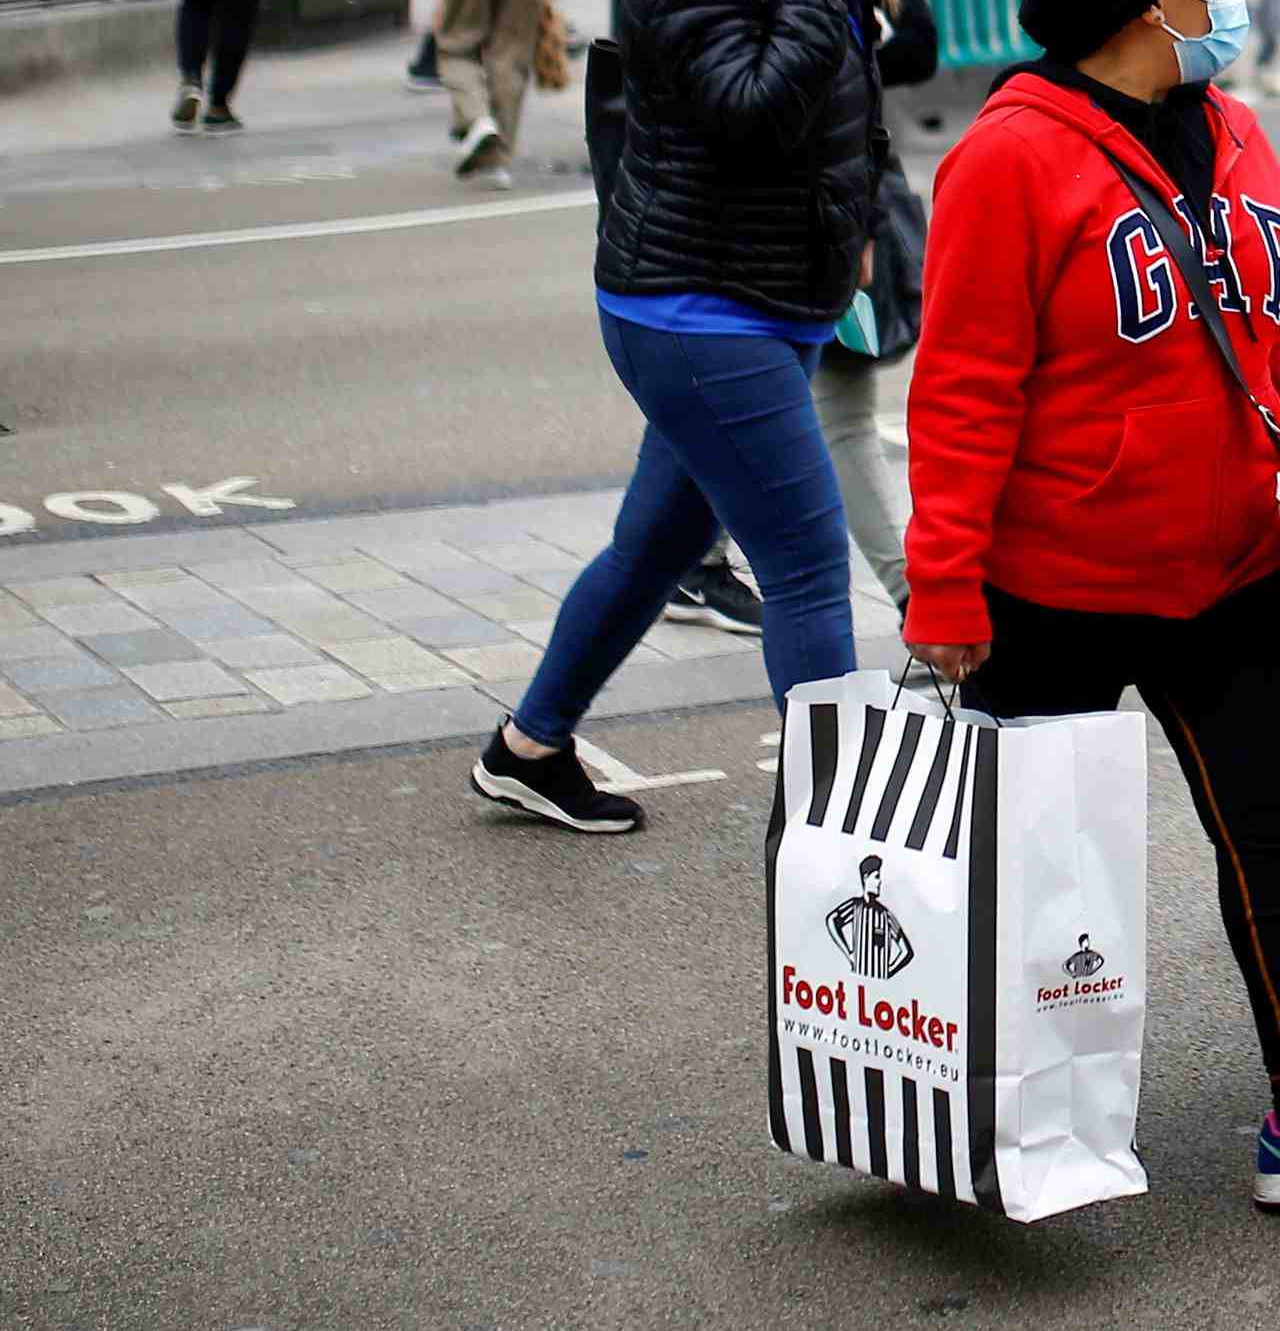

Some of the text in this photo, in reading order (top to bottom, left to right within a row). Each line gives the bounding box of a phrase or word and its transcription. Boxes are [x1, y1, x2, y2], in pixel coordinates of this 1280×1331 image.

[783, 964, 959, 1053] Foot Locker
[1036, 984, 1069, 1004] Foot
[1073, 976, 1124, 997] Locker
[783, 1017, 960, 1083] www.footlocker.eu
